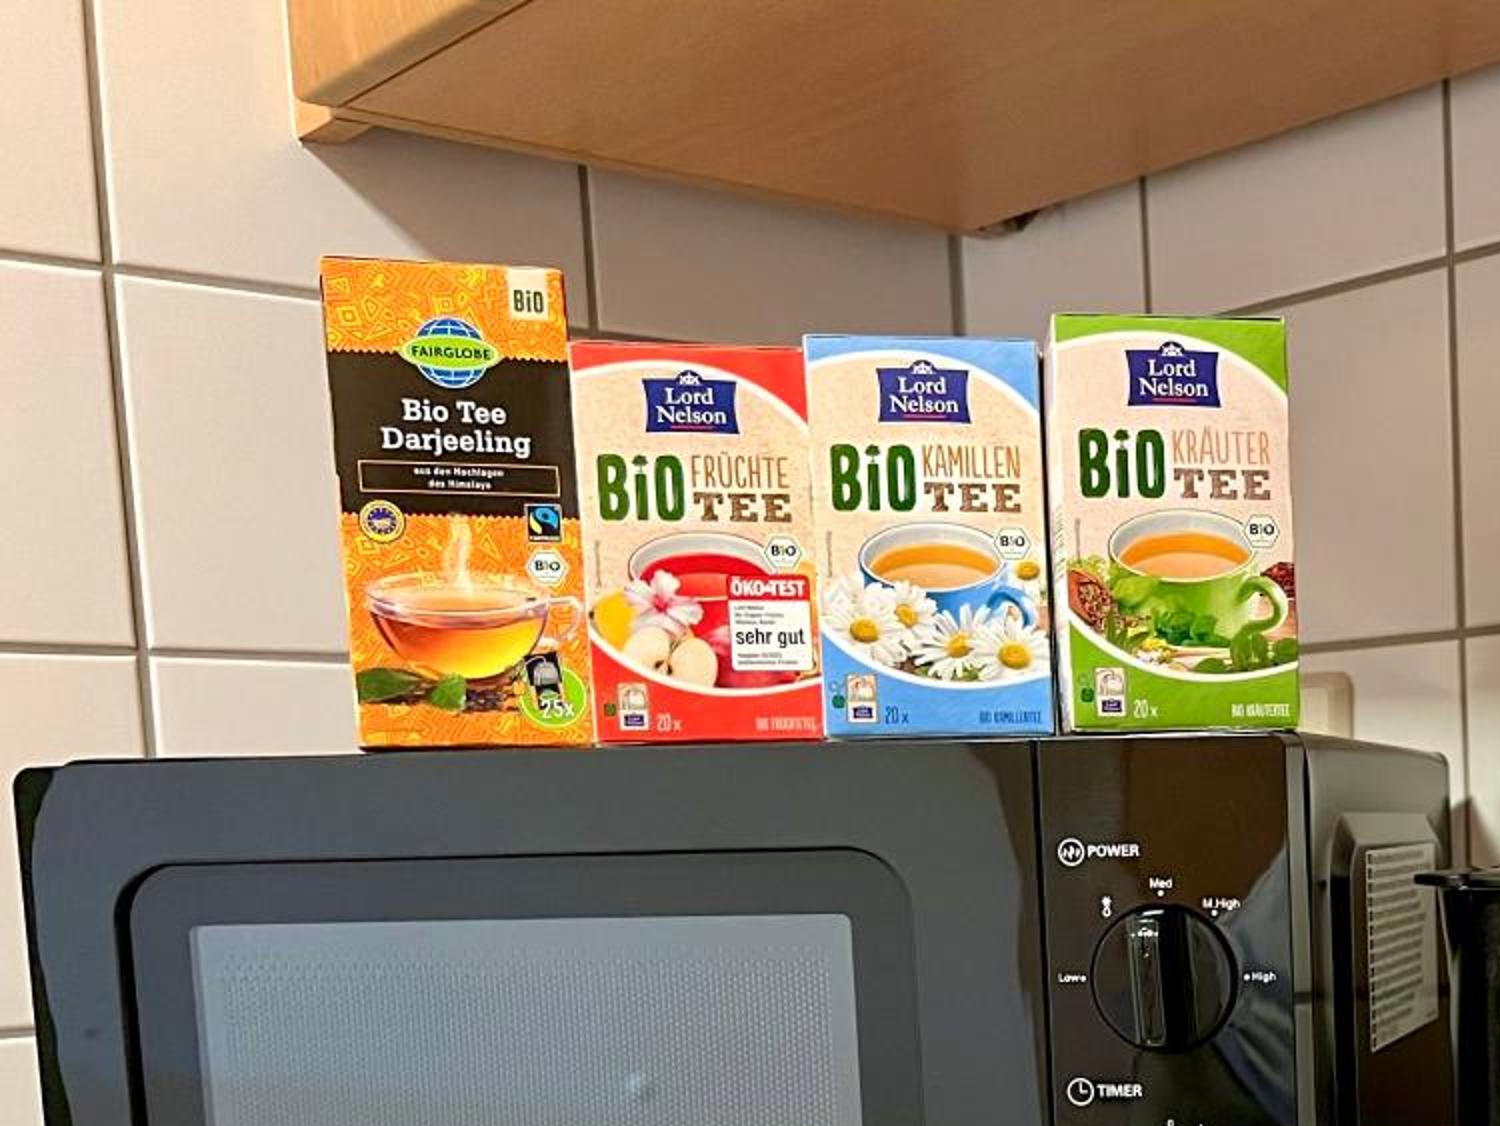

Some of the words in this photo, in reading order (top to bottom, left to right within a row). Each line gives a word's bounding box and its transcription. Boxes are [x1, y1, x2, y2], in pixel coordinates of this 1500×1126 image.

[411, 345, 491, 361] FAIRGLOBE
[1147, 359, 1197, 377] Lord
[897, 376, 946, 394] Lord
[1139, 377, 1209, 397] Nelson
[664, 387, 714, 405] Lord
[889, 394, 959, 413] Nelson
[401, 398, 449, 422] Bio
[456, 400, 507, 424] Tee
[656, 405, 727, 425] Nelson
[380, 426, 532, 459] Darjeeling
[1171, 425, 1271, 464] KRÄUTER
[691, 451, 788, 488] FRÜCHTE
[921, 444, 1021, 479] KAMILLEN
[1173, 468, 1271, 501] TEE
[924, 481, 1021, 513] TEE
[693, 492, 793, 523] TEE
[735, 628, 773, 645] sehr
[777, 628, 806, 649] gut
[1087, 843, 1140, 858] POWER
[1149, 877, 1173, 889] Med
[1058, 973, 1080, 983] Low
[1251, 971, 1277, 983] High
[1096, 1083, 1143, 1098] TIMER
